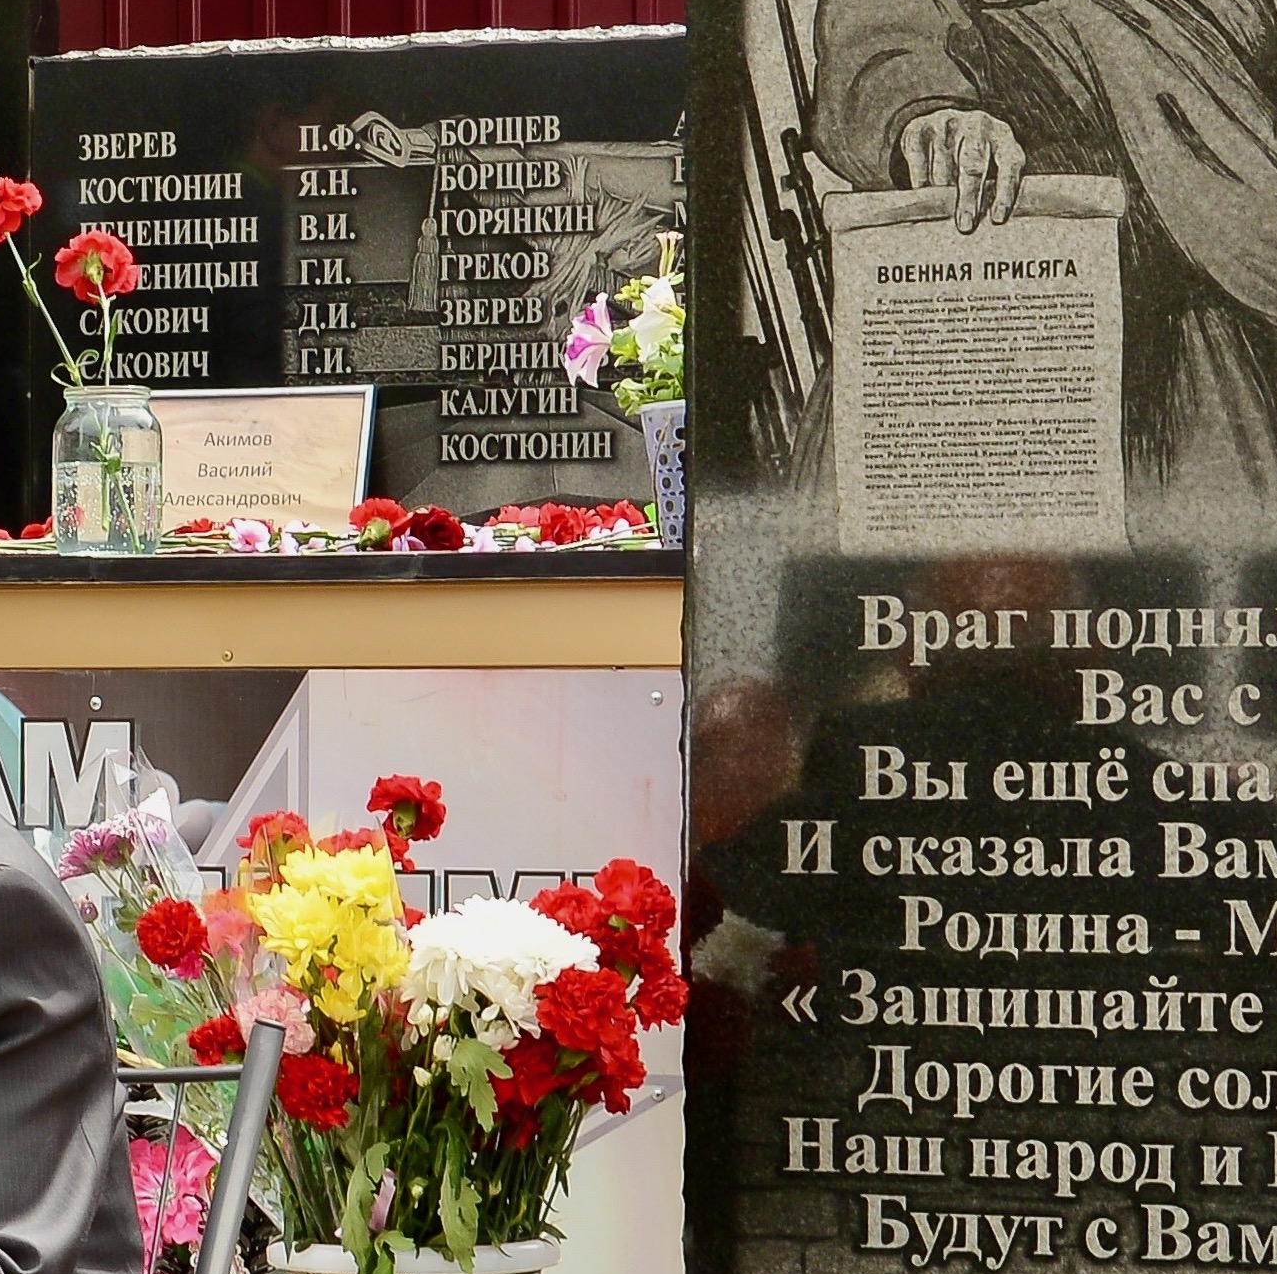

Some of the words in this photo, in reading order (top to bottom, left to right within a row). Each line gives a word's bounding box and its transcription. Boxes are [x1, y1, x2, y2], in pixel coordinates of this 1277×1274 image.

[78, 131, 177, 161] ЗВЕРЕВ
[298, 124, 362, 152] П.Ф.
[439, 114, 561, 148] БОРЩЕВ
[79, 172, 243, 205] КОСТЮНИН
[298, 169, 357, 197] Я.Н.
[439, 160, 561, 194] БОРЩЕВ
[299, 212, 356, 241] В.И.
[439, 204, 596, 237] ГОРЯНКИН
[124, 260, 259, 294] ЕНИЦЫН
[299, 258, 352, 286] Г.И.
[439, 251, 551, 282] ГРЕКОВ
[877, 263, 972, 284] ВОЕННАЯ
[984, 259, 1077, 280] ПРИСЯГА
[298, 302, 357, 337] Д.И.
[440, 297, 543, 327] ЗВЕРЕВ
[299, 347, 352, 375] Г.И.
[440, 342, 609, 376] БЕРДНИК
[440, 386, 579, 417] КАЛУГИН
[204, 432, 272, 447] Акимов
[440, 431, 612, 462] КОСТЮНИН
[198, 461, 272, 478] Василий
[164, 492, 301, 508] Александрович
[857, 594, 1028, 666] Враг
[1076, 669, 1204, 727] Вас
[1228, 684, 1262, 726] с
[858, 745, 968, 801] Вы
[993, 748, 1128, 809] ещё
[781, 820, 838, 876] И
[863, 834, 1135, 879] сказала
[900, 895, 1151, 959] Родина
[840, 969, 1264, 1036] Защищайте
[858, 1044, 1154, 1118] Дорогие
[782, 1118, 944, 1174] Наш
[969, 1134, 1175, 1198] народ
[1200, 1142, 1240, 1186] и
[861, 1195, 1062, 1270] Будут
[1087, 1217, 1118, 1259] с
